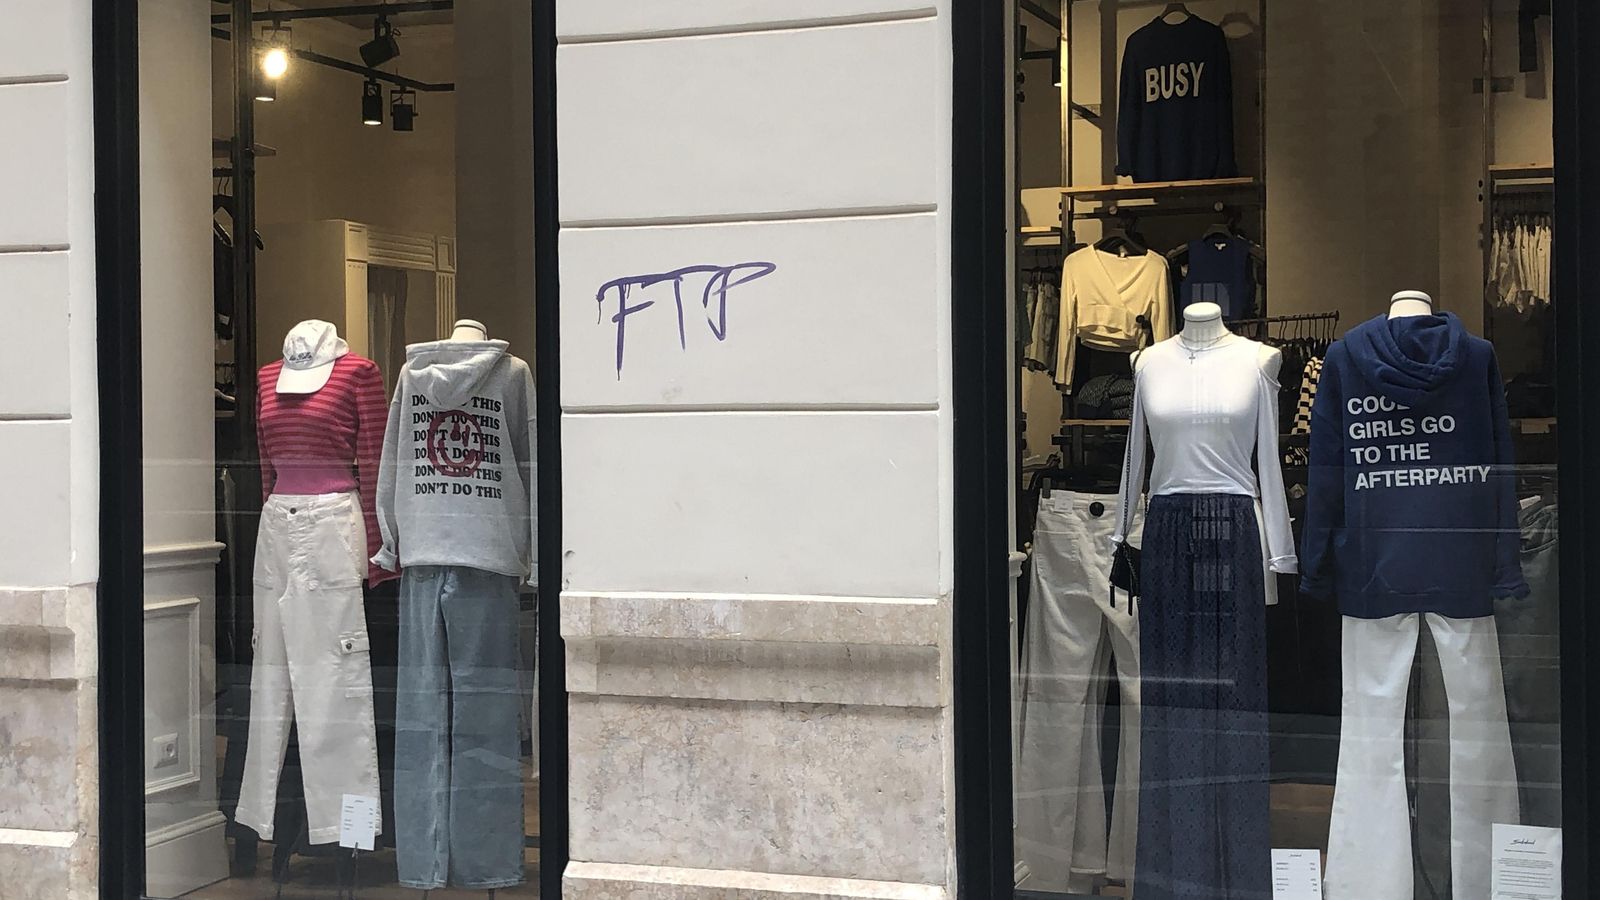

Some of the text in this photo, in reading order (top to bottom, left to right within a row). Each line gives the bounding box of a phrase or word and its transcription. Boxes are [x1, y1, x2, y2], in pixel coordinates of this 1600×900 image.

[1145, 62, 1204, 102] BUSY
[596, 261, 777, 381] FTP
[471, 396, 501, 412] THIS
[471, 414, 500, 430] THIS
[1349, 415, 1456, 440] GIRLS GO
[471, 432, 500, 447] THIS
[1350, 443, 1431, 465] TO THE
[476, 468, 502, 482] THIS
[1354, 465, 1491, 491] AFTERPARTY
[415, 482, 502, 499] DON'T DO THIS
